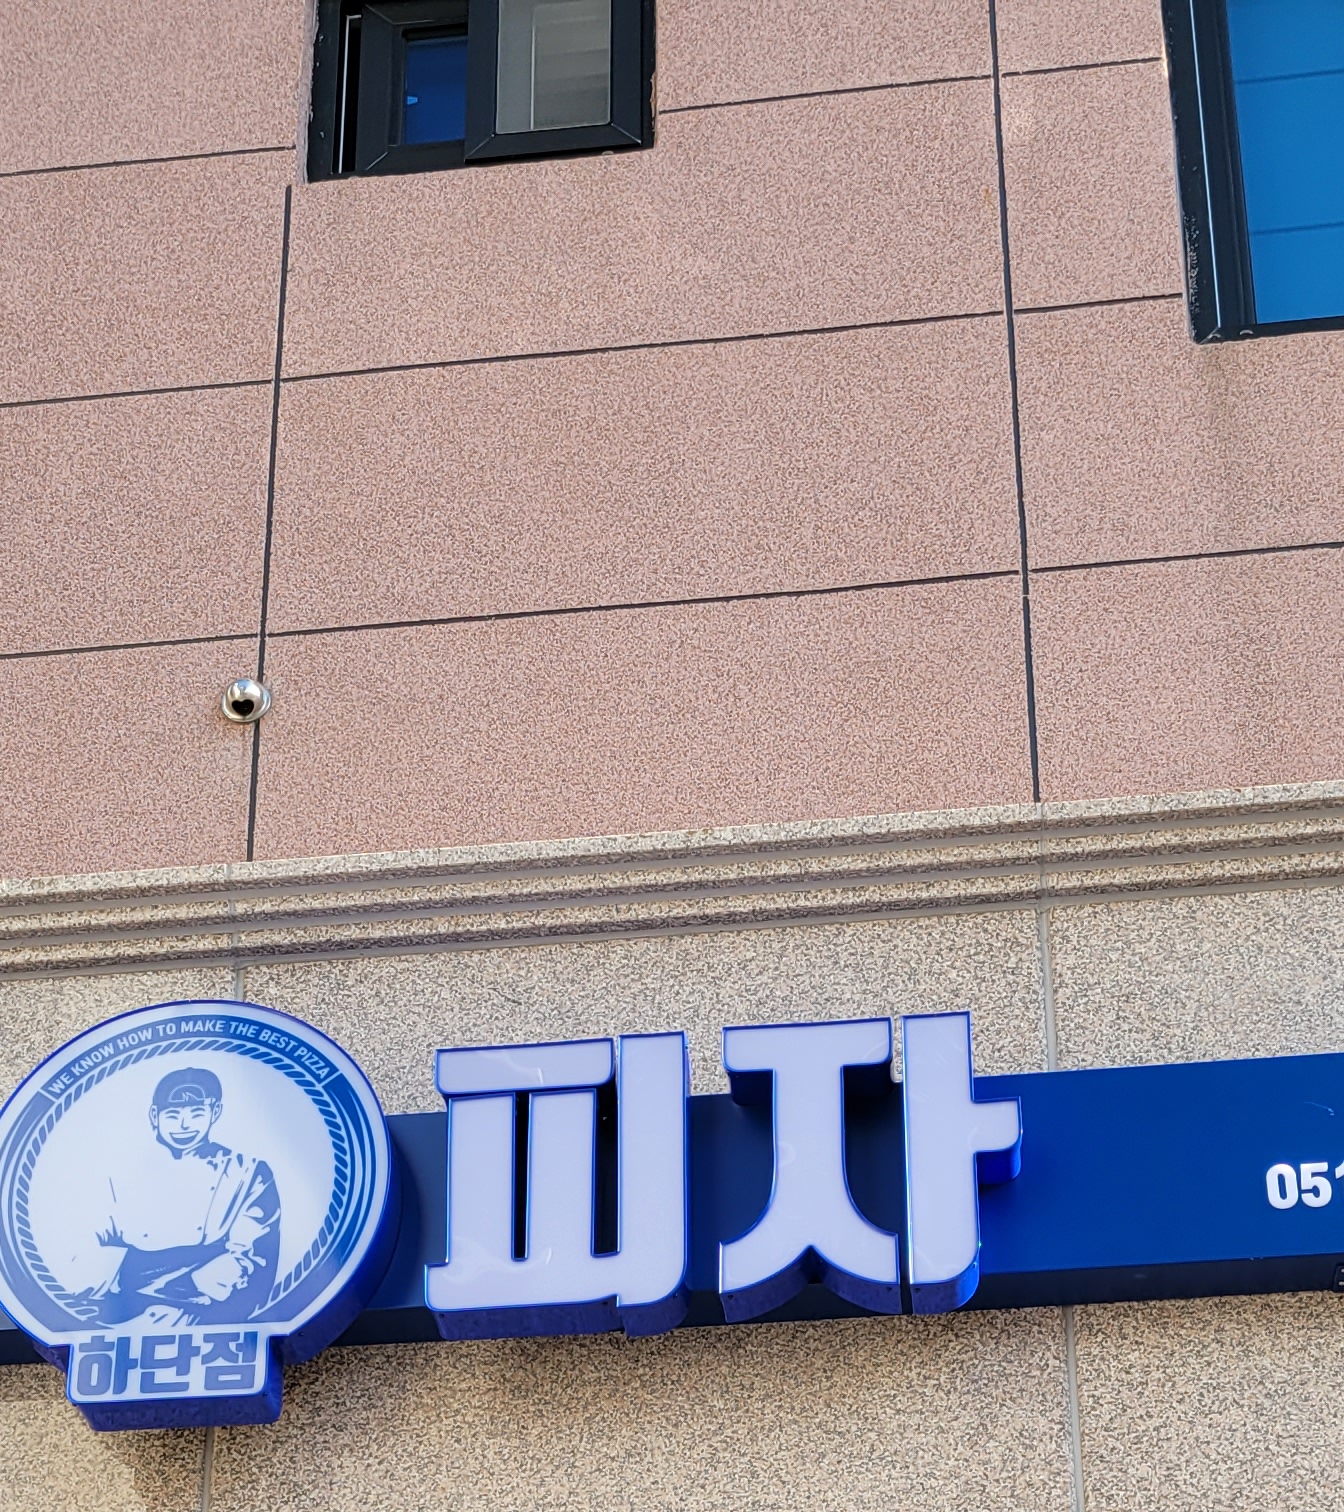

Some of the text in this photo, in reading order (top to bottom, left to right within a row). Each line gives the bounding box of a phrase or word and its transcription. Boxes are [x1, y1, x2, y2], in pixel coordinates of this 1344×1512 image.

[48, 1019, 331, 1095] WE KNOW HOW TO MAKE THE BEST PIZZA
[424, 1010, 1024, 1325] 피자
[76, 1331, 258, 1396] 하단점
